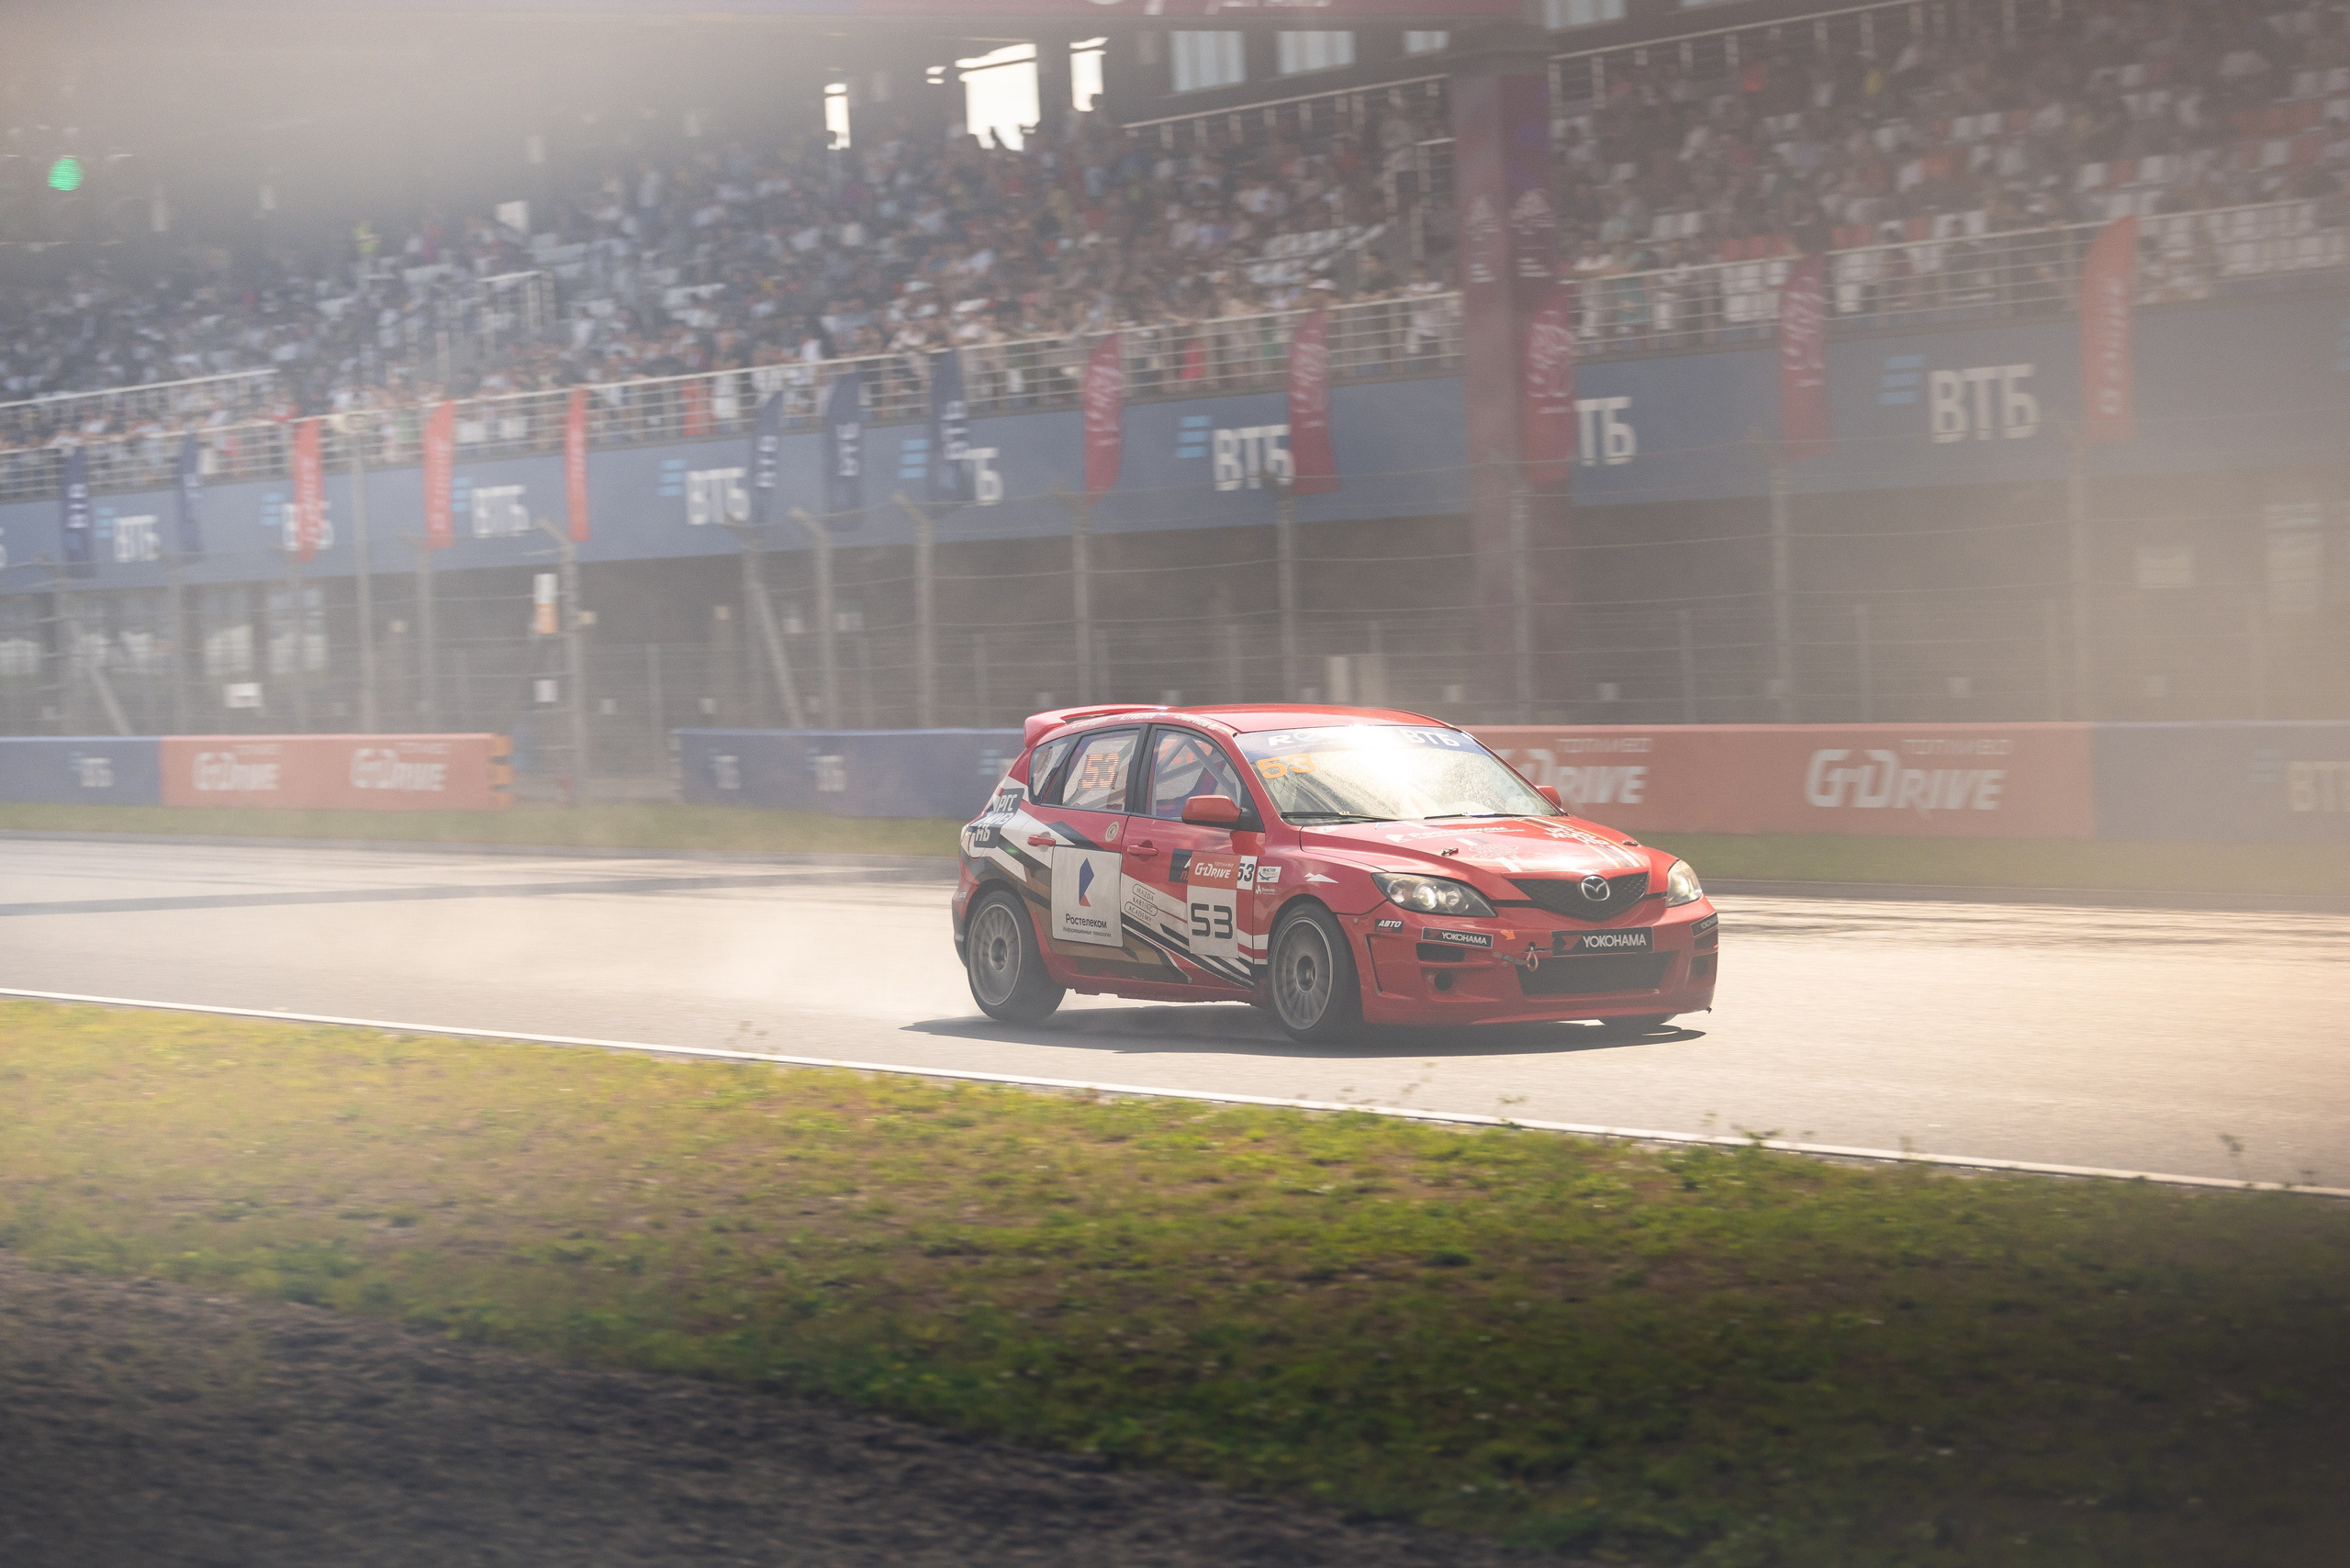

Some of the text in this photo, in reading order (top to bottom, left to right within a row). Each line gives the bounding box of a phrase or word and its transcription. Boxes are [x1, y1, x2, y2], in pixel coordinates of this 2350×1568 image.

[1929, 364, 2041, 444] ВТБ
[1572, 396, 1638, 466] ТБ
[1212, 423, 1295, 491] ВТБ
[1081, 753, 1119, 789] 53
[1258, 753, 1316, 778] 53
[2288, 761, 2350, 812] ВТ
[1133, 896, 1153, 913] KARTING
[1136, 887, 1154, 902] MAZDA
[1065, 913, 1107, 928] Ростелеком
[1129, 905, 1152, 924] ACADEMY
[1191, 903, 1233, 939] 53
[1441, 932, 1487, 945] YOKOHAMA
[1583, 934, 1646, 948] YOKOHAMA
